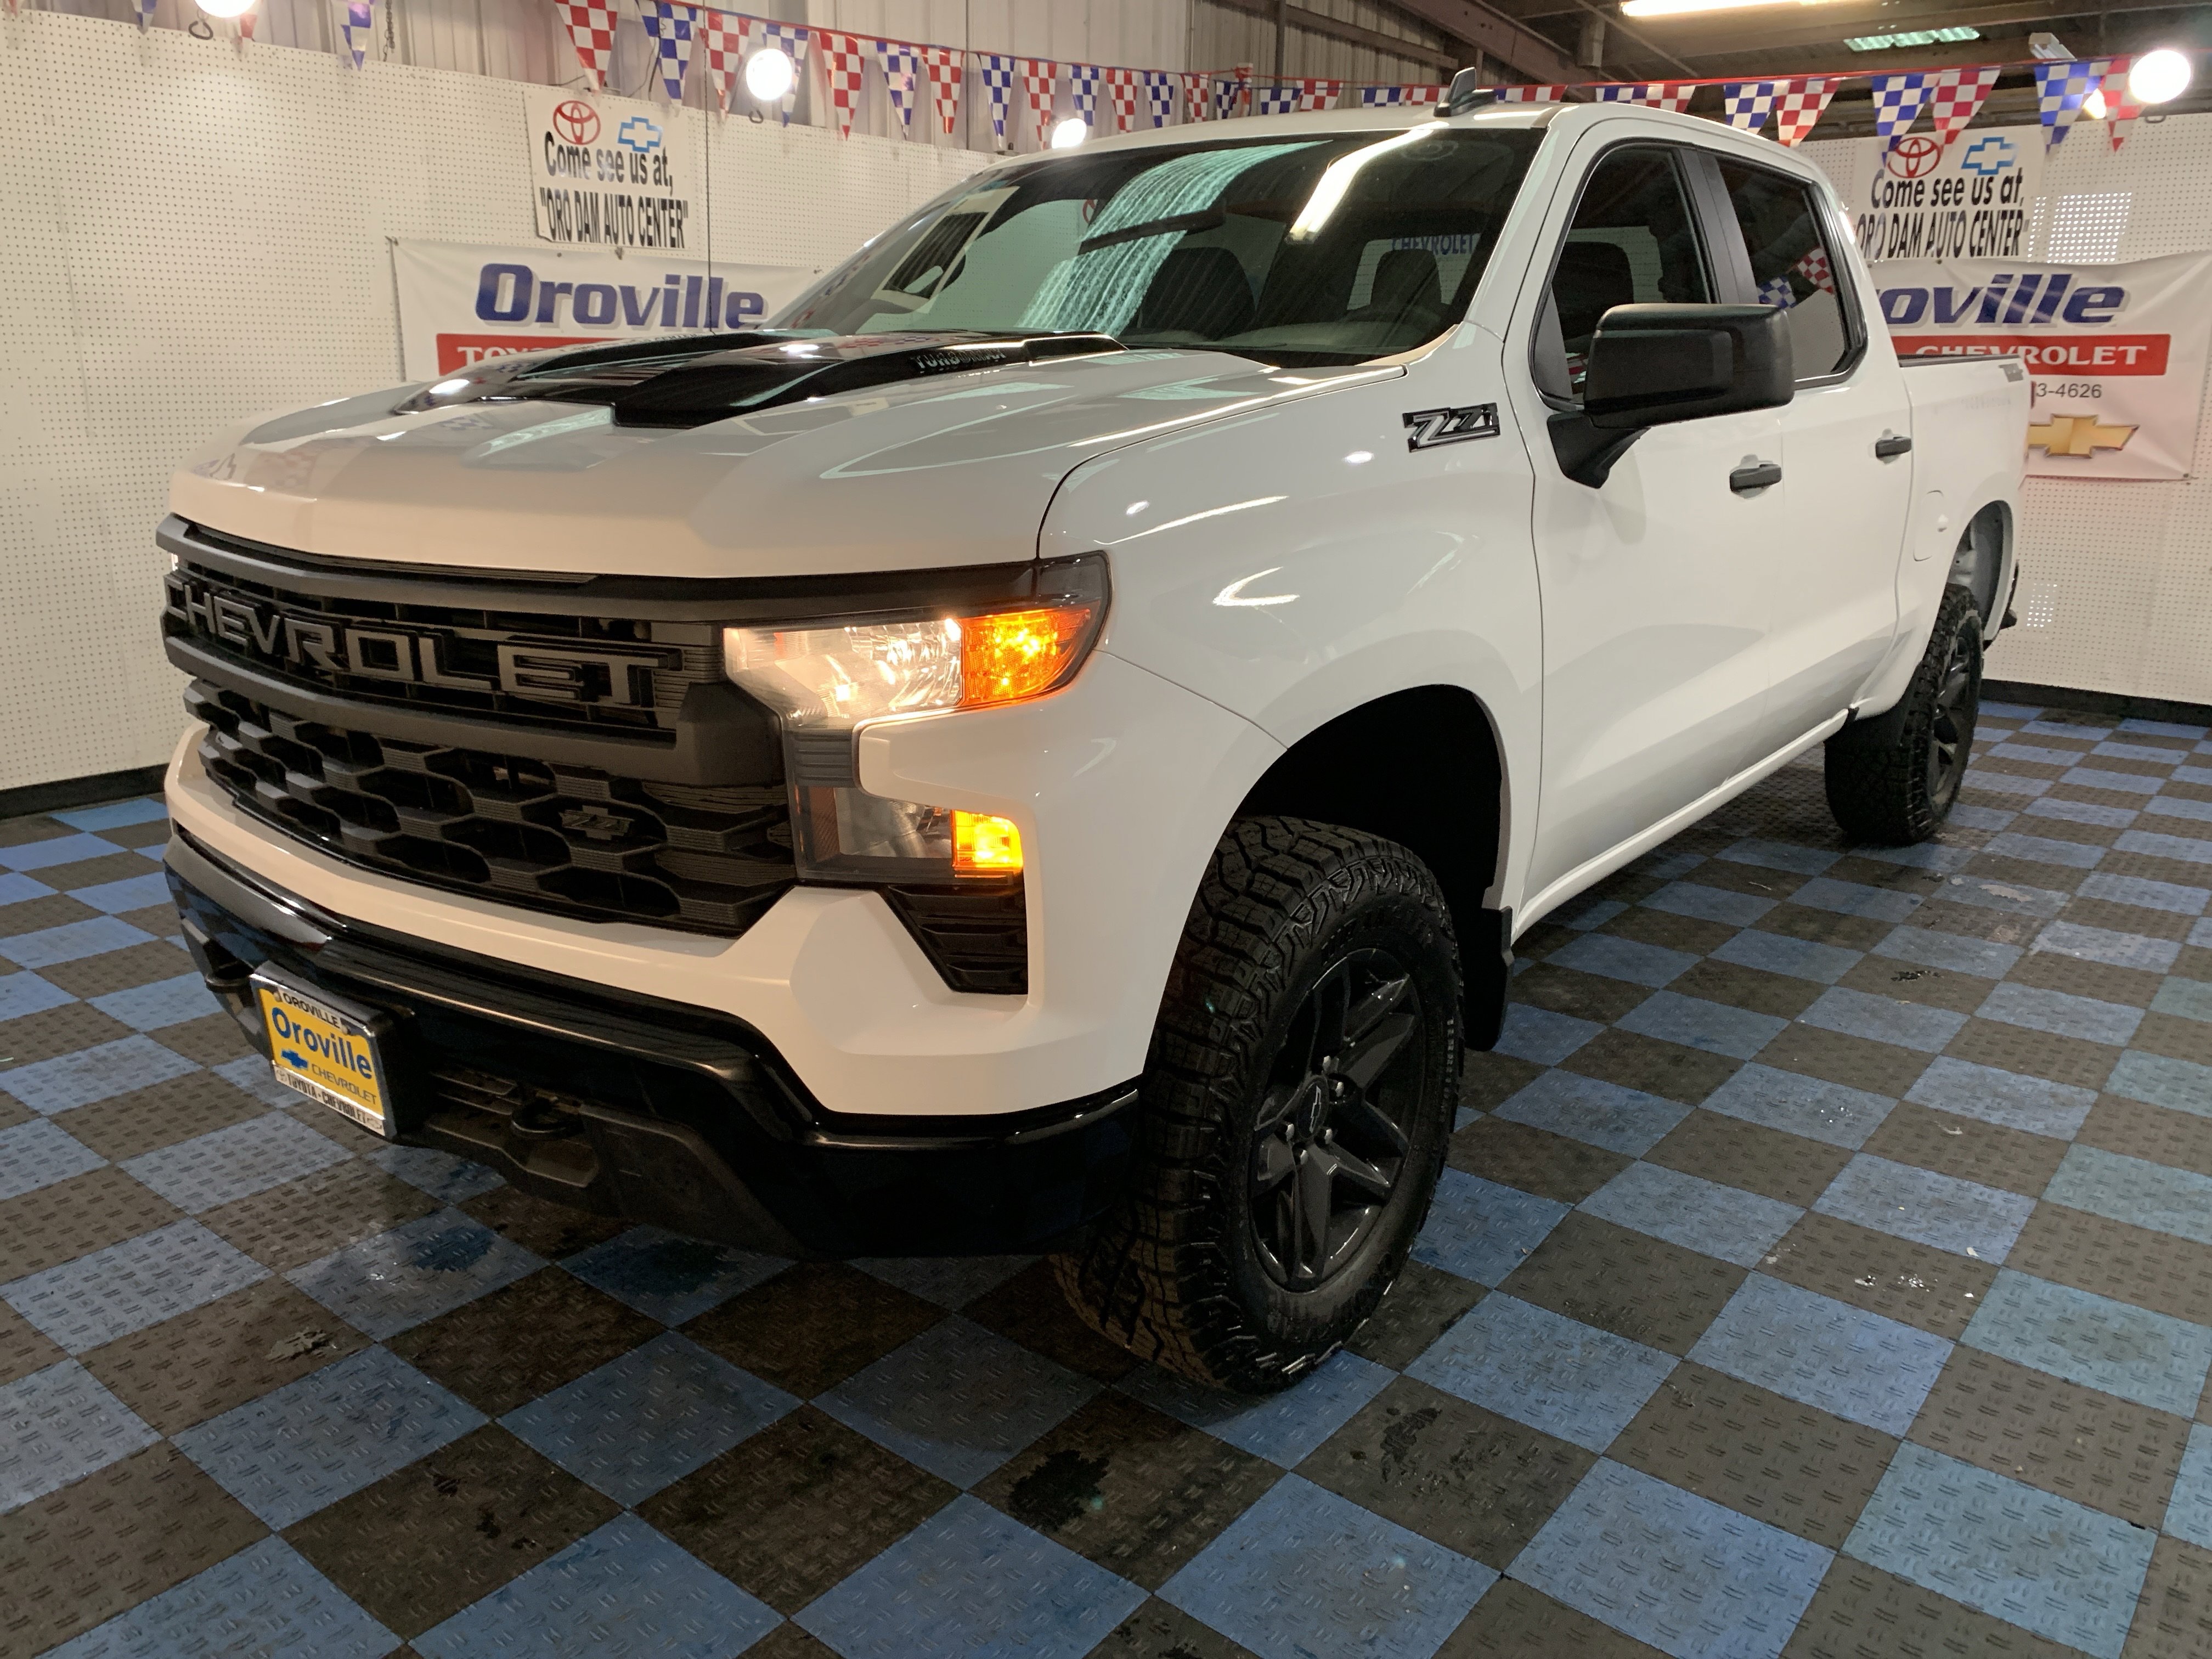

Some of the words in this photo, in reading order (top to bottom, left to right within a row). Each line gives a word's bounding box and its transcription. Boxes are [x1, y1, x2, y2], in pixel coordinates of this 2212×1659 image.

[544, 131, 591, 180] Come
[596, 149, 625, 183] see
[629, 151, 648, 185] us
[653, 145, 674, 196] at,
[1871, 168, 1926, 209] Come
[1930, 176, 1965, 207] see
[1971, 175, 1994, 206] us
[2000, 167, 2025, 207] at,
[574, 190, 601, 244] DAM
[604, 193, 634, 246] AUTO
[1887, 212, 1925, 259] DAM
[1925, 209, 1967, 258] AUTO
[475, 263, 764, 329] Oroville
[1876, 273, 2125, 324] oville
[163, 574, 684, 709] CHEVROLET
[283, 992, 340, 1029] OROVILLE
[272, 1007, 373, 1080] Oroville
[311, 1063, 377, 1105] CHEVROLET
